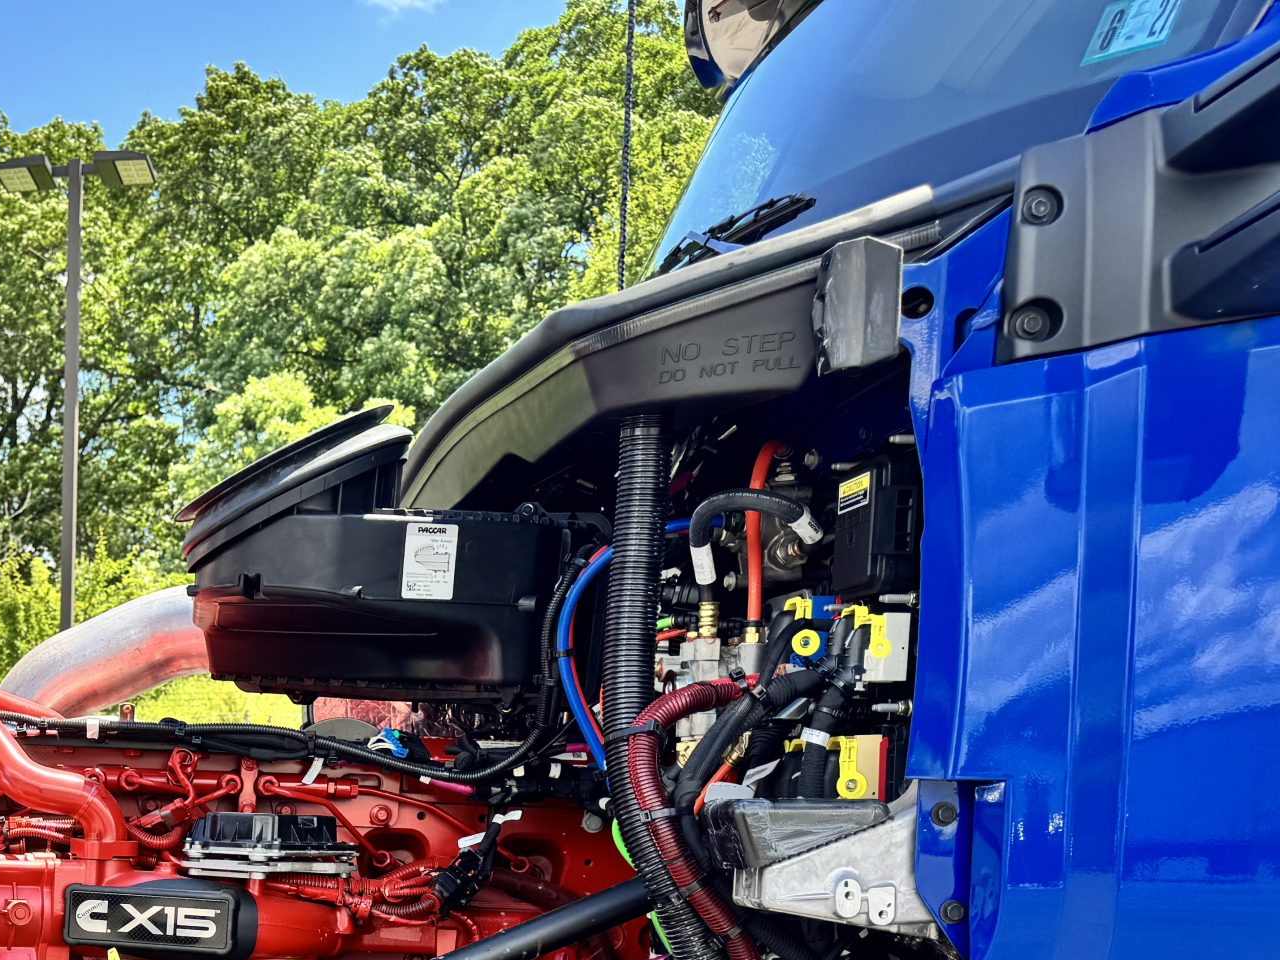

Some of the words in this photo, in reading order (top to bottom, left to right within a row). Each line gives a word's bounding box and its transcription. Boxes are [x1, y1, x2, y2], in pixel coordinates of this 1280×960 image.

[660, 342, 701, 365] NO
[722, 331, 797, 357] STEP
[658, 368, 686, 384] DO
[699, 361, 740, 379] NOT
[752, 355, 801, 373] PULL
[418, 526, 447, 534] PACCAR
[117, 903, 218, 939] X15
